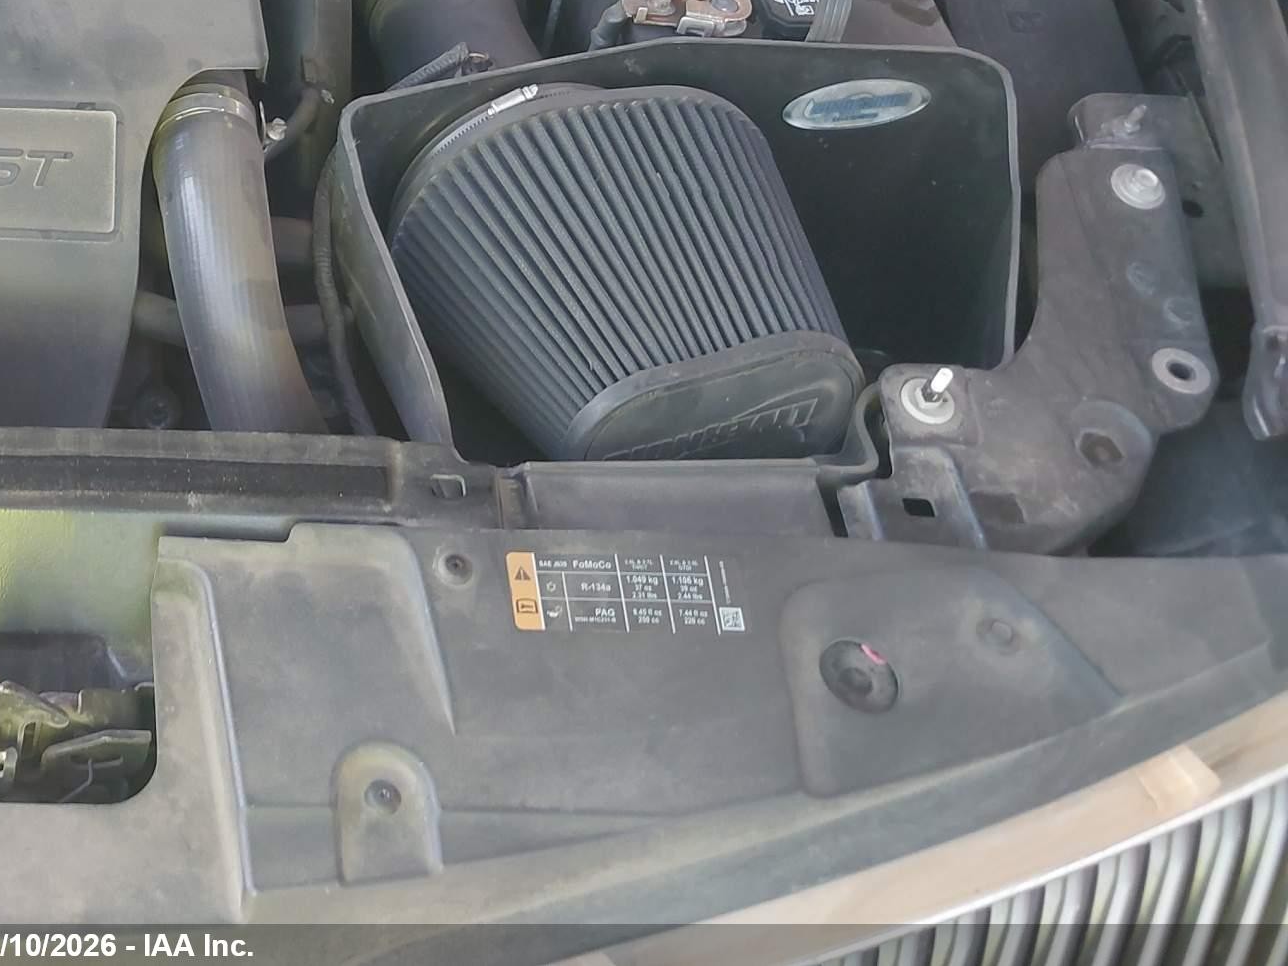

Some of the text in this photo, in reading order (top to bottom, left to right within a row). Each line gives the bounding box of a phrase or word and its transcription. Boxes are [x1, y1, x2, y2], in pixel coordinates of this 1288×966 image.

[538, 560, 552, 568] SAE
[572, 559, 612, 569] FoMoCo
[647, 575, 659, 586] kg
[693, 576, 704, 587] kg
[581, 581, 612, 592] R-134a
[595, 607, 615, 617] PAG
